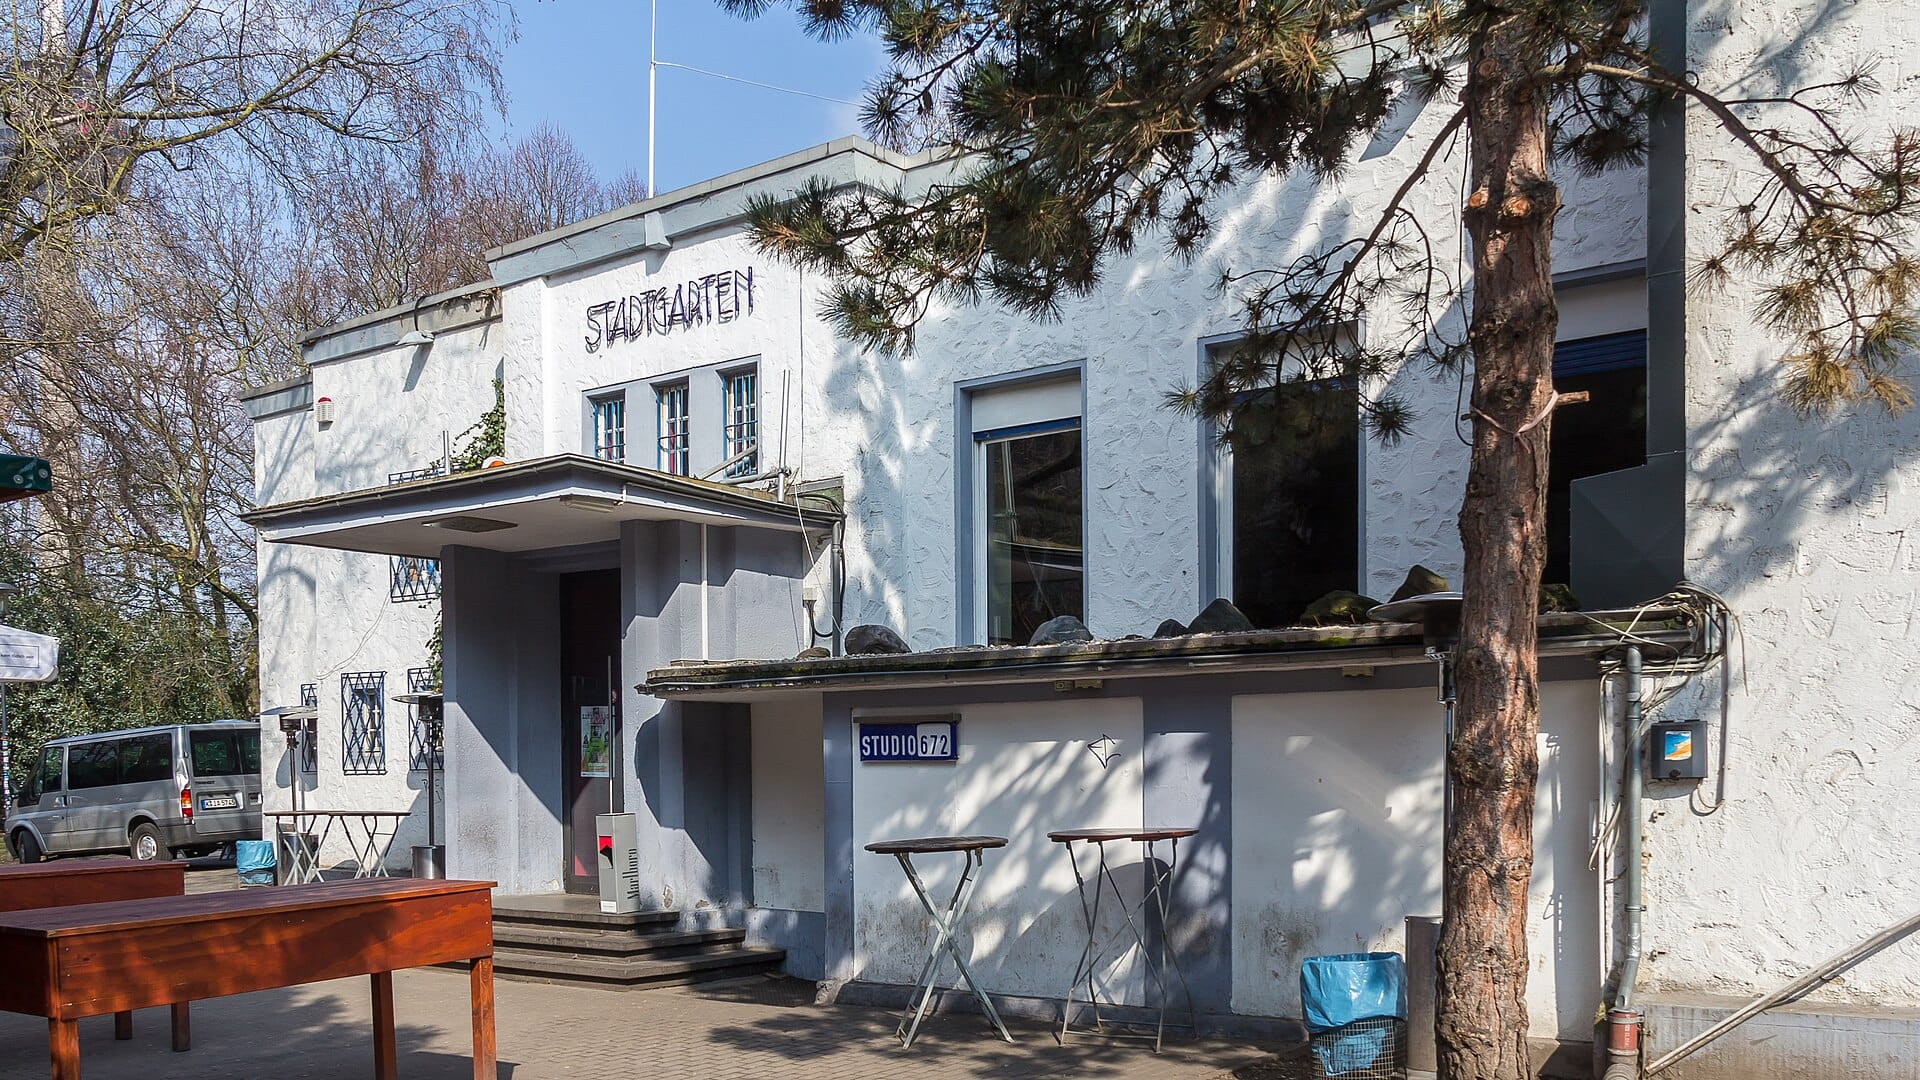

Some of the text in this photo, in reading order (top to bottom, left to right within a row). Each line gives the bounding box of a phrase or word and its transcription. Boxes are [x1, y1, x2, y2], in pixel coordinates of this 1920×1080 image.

[585, 266, 753, 346] STADTGARTEN
[862, 734, 948, 756] STUDIO 672
[622, 849, 640, 899] Marlboro
